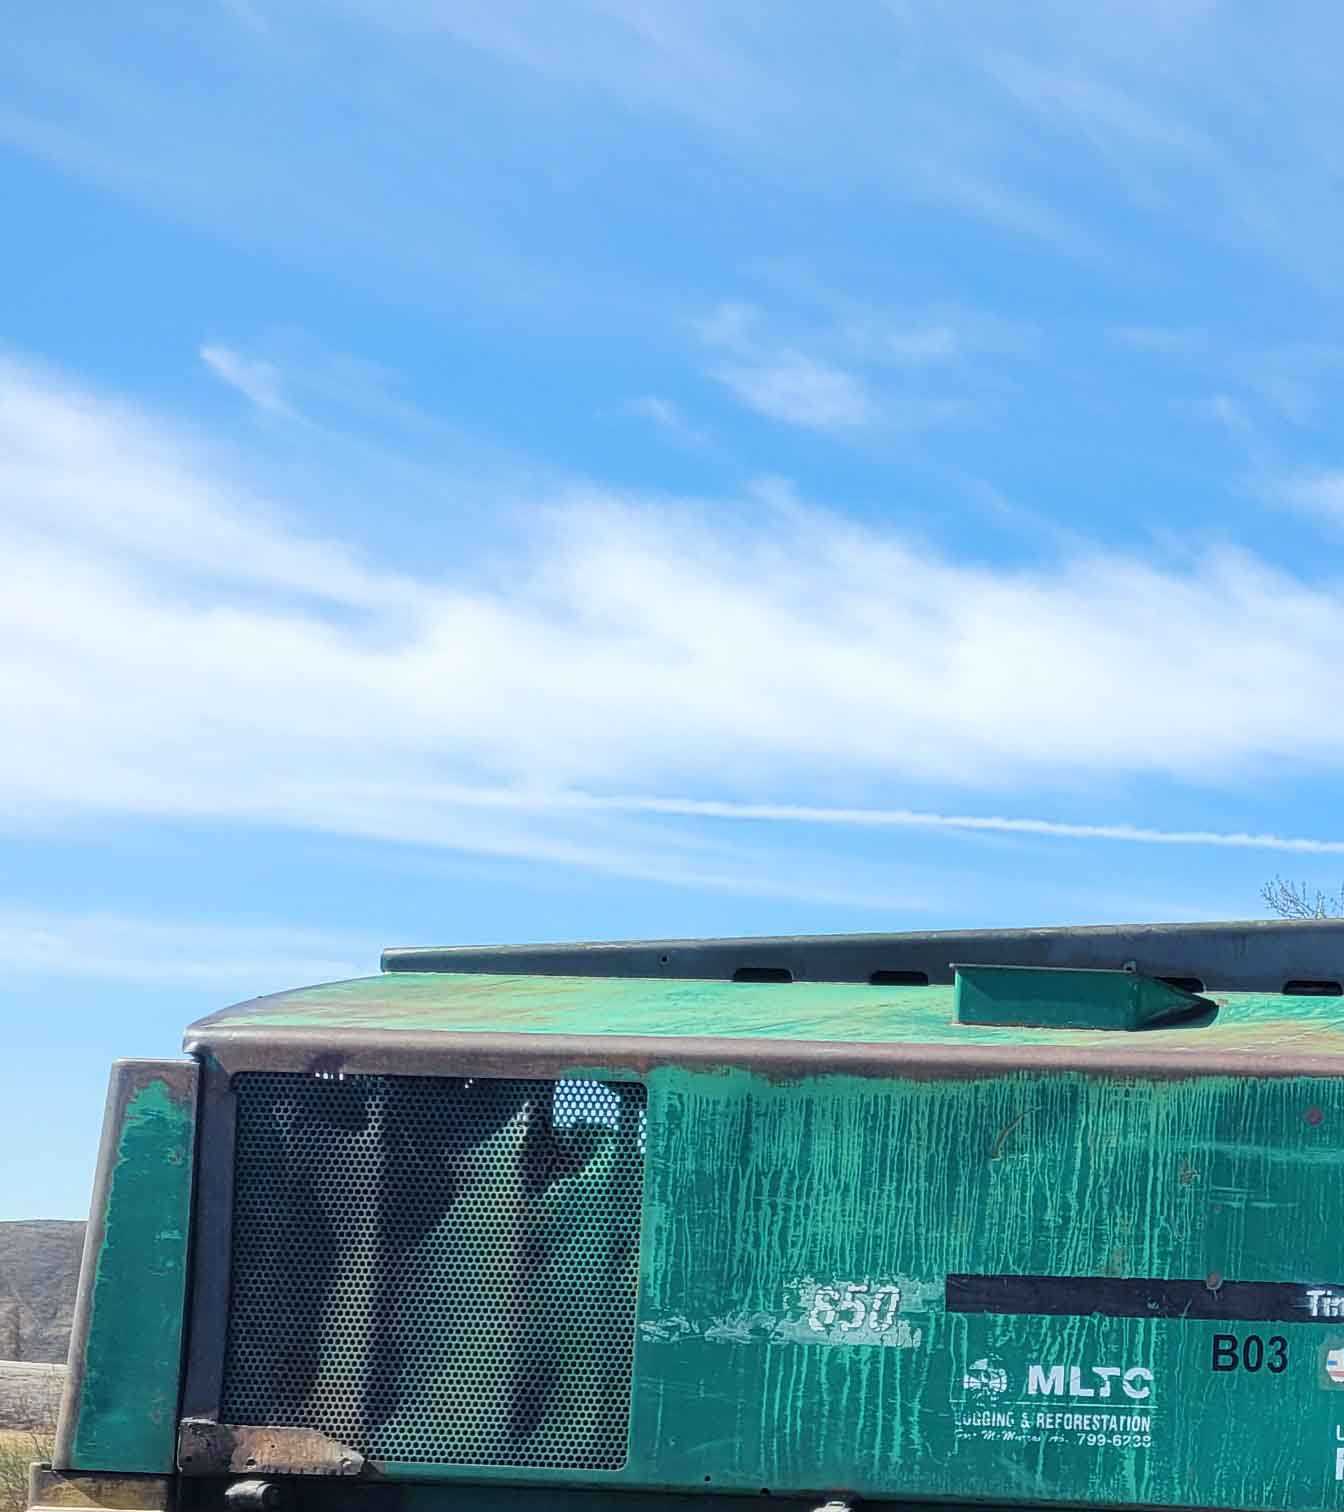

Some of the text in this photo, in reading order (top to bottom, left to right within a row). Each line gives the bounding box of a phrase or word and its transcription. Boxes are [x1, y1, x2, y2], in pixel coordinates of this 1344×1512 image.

[1212, 1334, 1289, 1373] B03
[1027, 1364, 1155, 1399] MLTC
[1020, 1411, 1031, 1428] &
[1036, 1413, 1151, 1433] REFORESTATION
